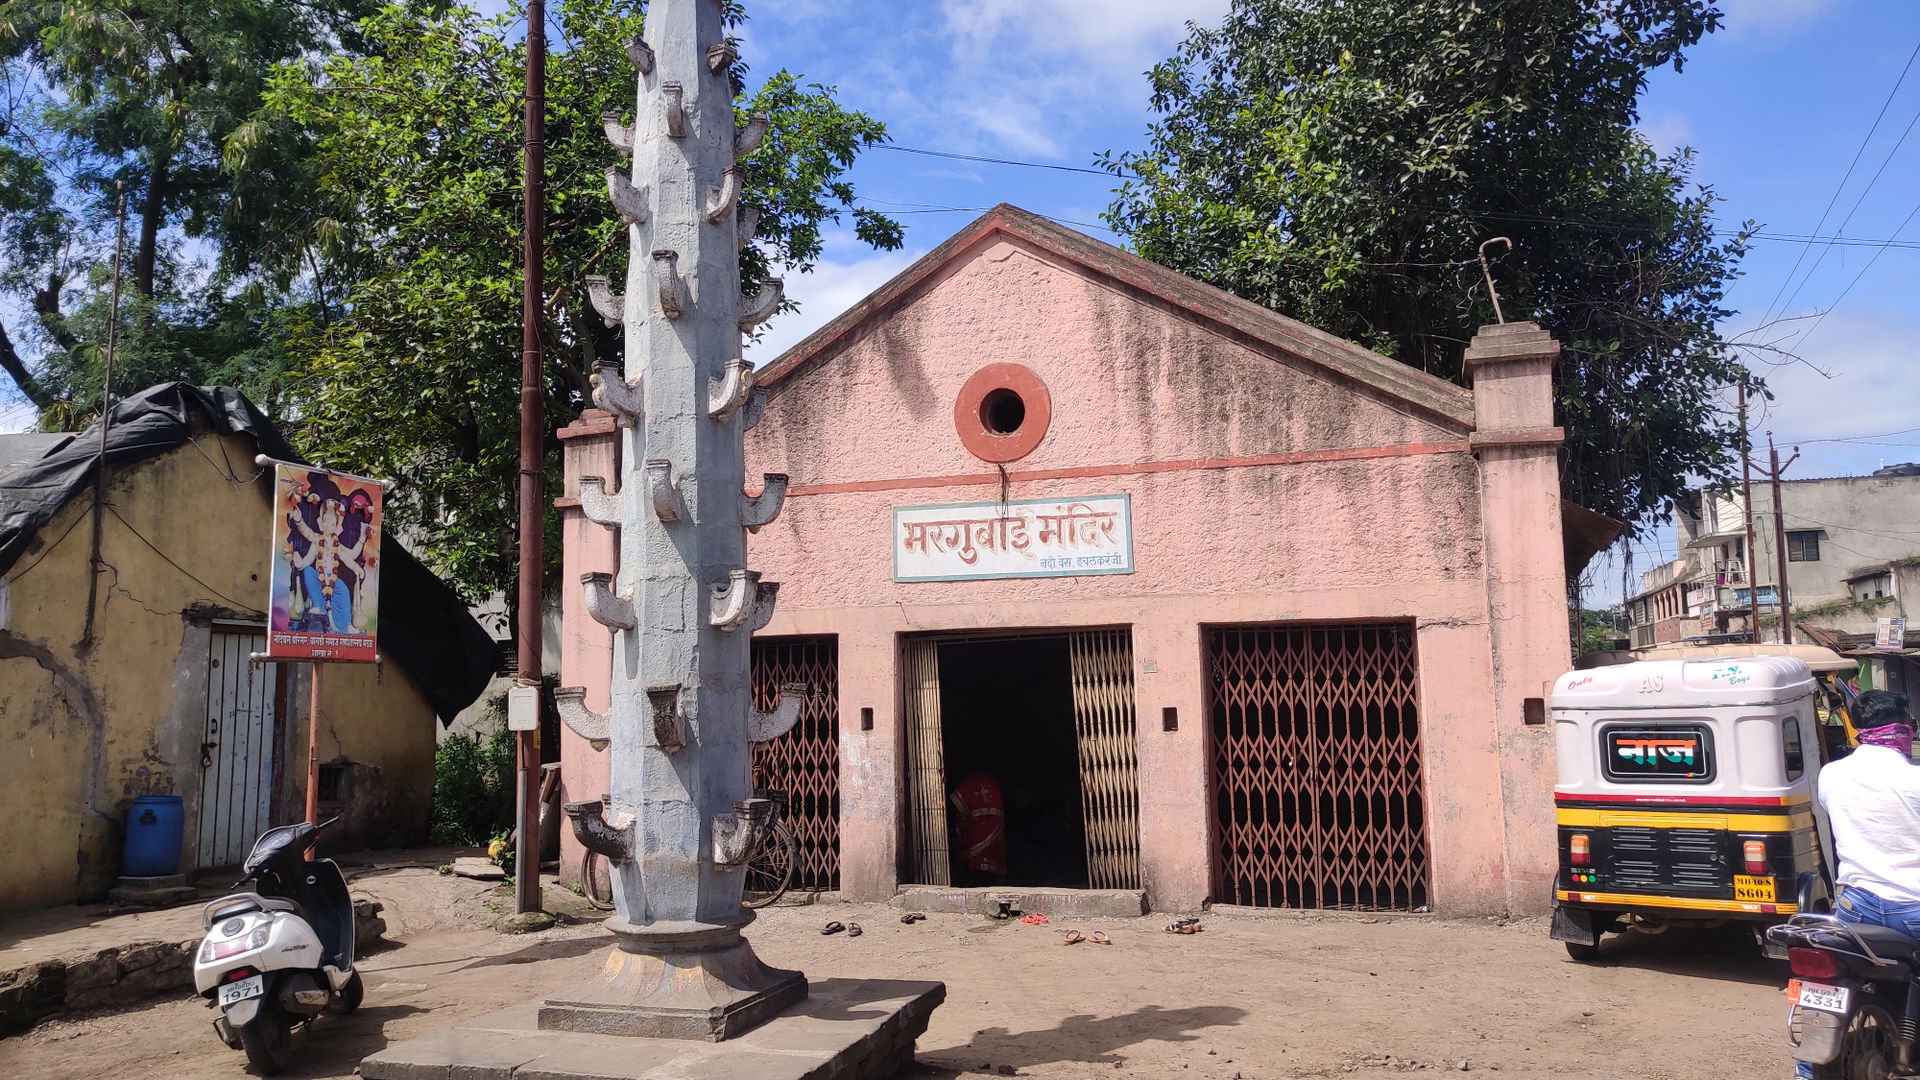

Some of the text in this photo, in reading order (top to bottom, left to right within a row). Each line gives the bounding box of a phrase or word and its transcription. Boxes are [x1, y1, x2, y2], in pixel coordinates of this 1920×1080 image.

[1036, 502, 1119, 549] मंदिर
[1077, 552, 1122, 568] इचलकरंजी
[1568, 676, 1592, 690] Only
[1616, 739, 1697, 766] नाज
[1737, 888, 1772, 899] 8604
[223, 985, 260, 1003] 1971
[1803, 994, 1843, 1010] 4331
